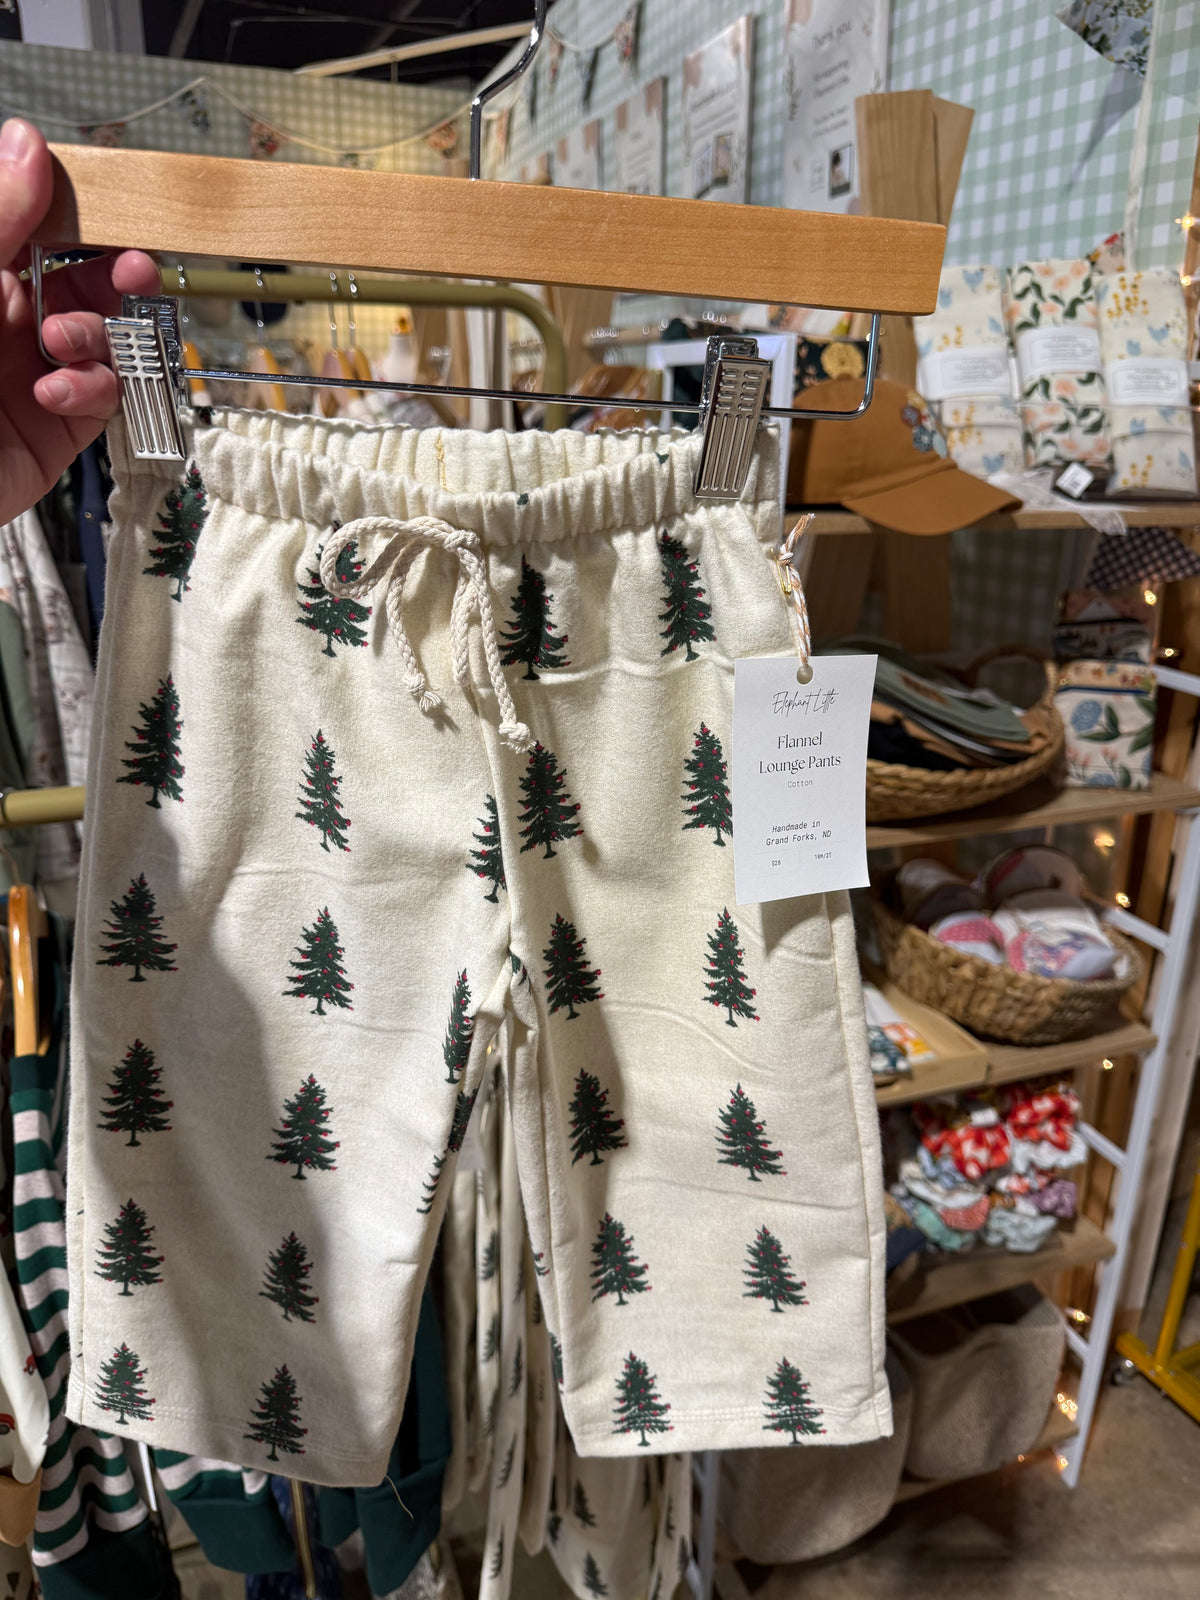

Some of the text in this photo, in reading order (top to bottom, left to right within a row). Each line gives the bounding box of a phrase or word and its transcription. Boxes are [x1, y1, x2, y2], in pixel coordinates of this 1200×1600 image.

[772, 690, 819, 718] Elephant
[778, 731, 823, 749] Flannel
[759, 755, 841, 775] Lounge Pants
[787, 779, 813, 788] Cotton
[772, 820, 820, 833] Handmade in
[766, 830, 832, 846] Grand Forks, ND
